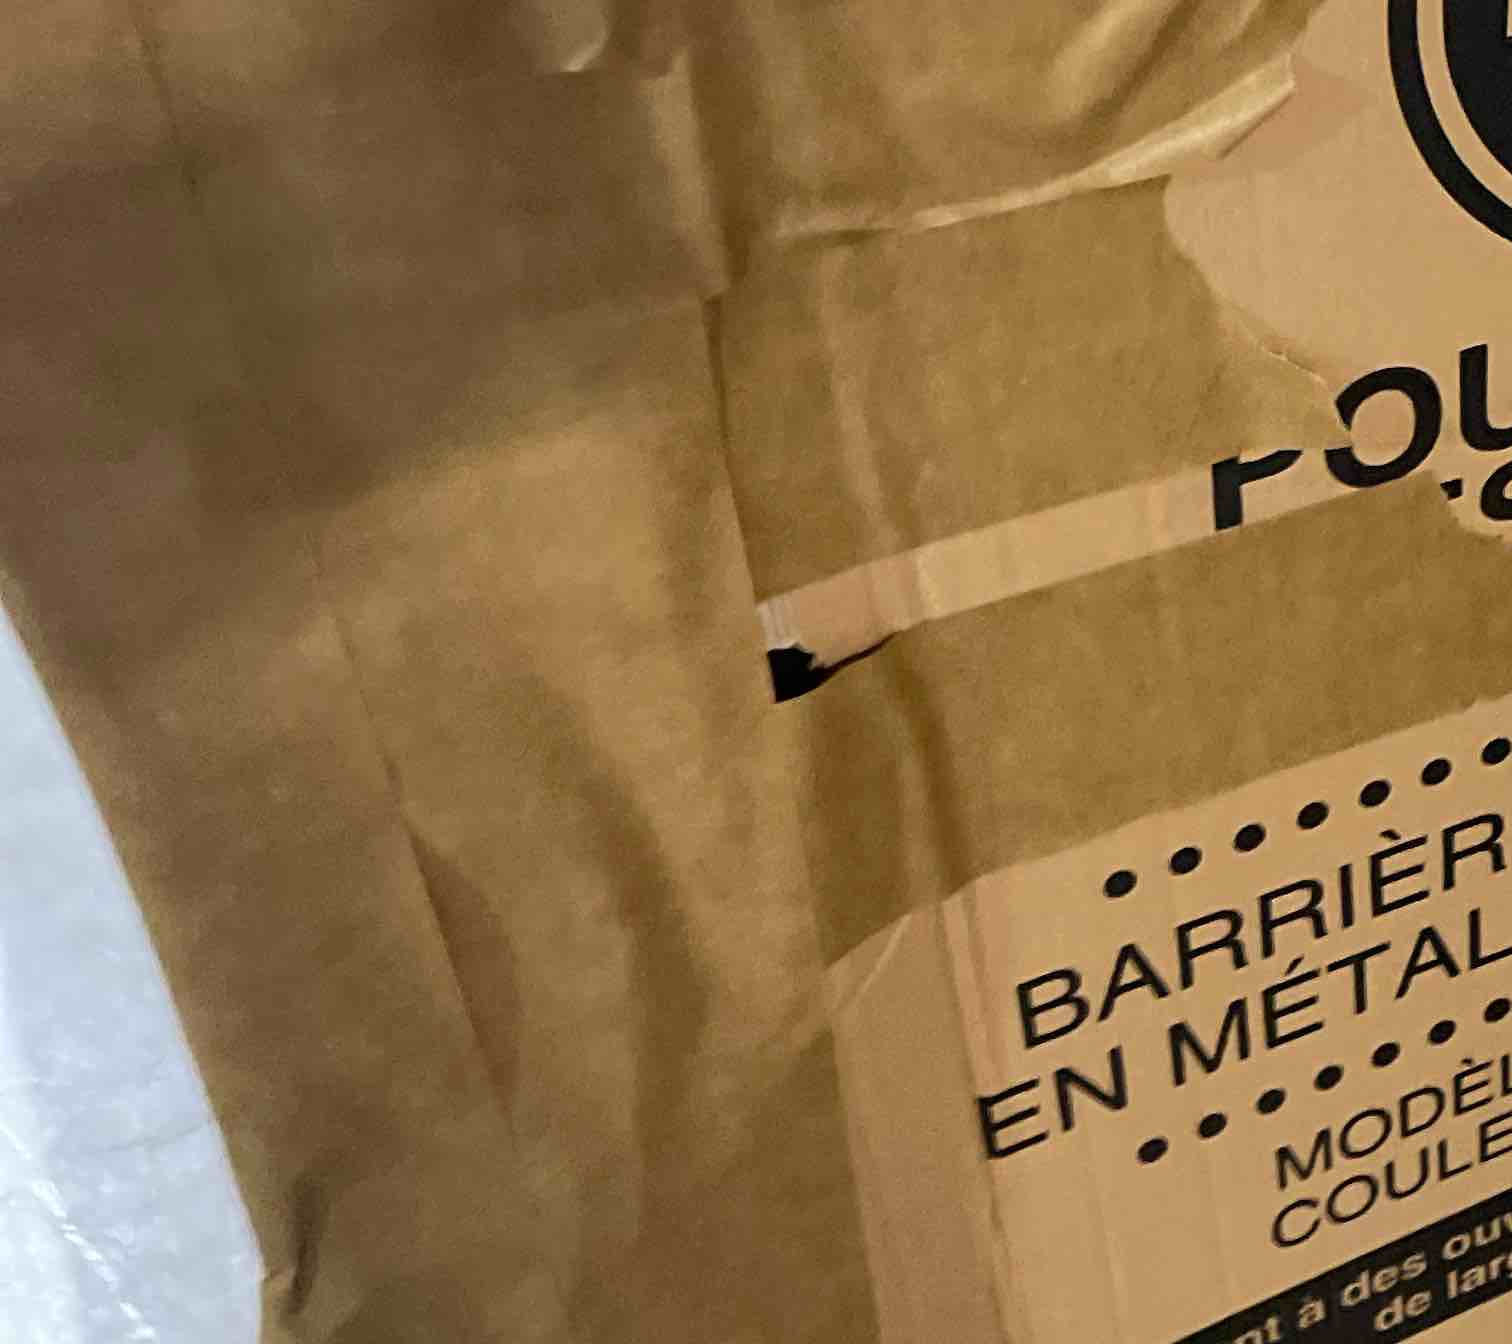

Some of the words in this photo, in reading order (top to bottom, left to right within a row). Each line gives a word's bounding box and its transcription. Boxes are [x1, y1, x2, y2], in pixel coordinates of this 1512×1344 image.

[977, 1046, 1129, 1160] EN
[1297, 1290, 1328, 1331] à
[1339, 1250, 1430, 1310] des
[1371, 1287, 1433, 1336] de
